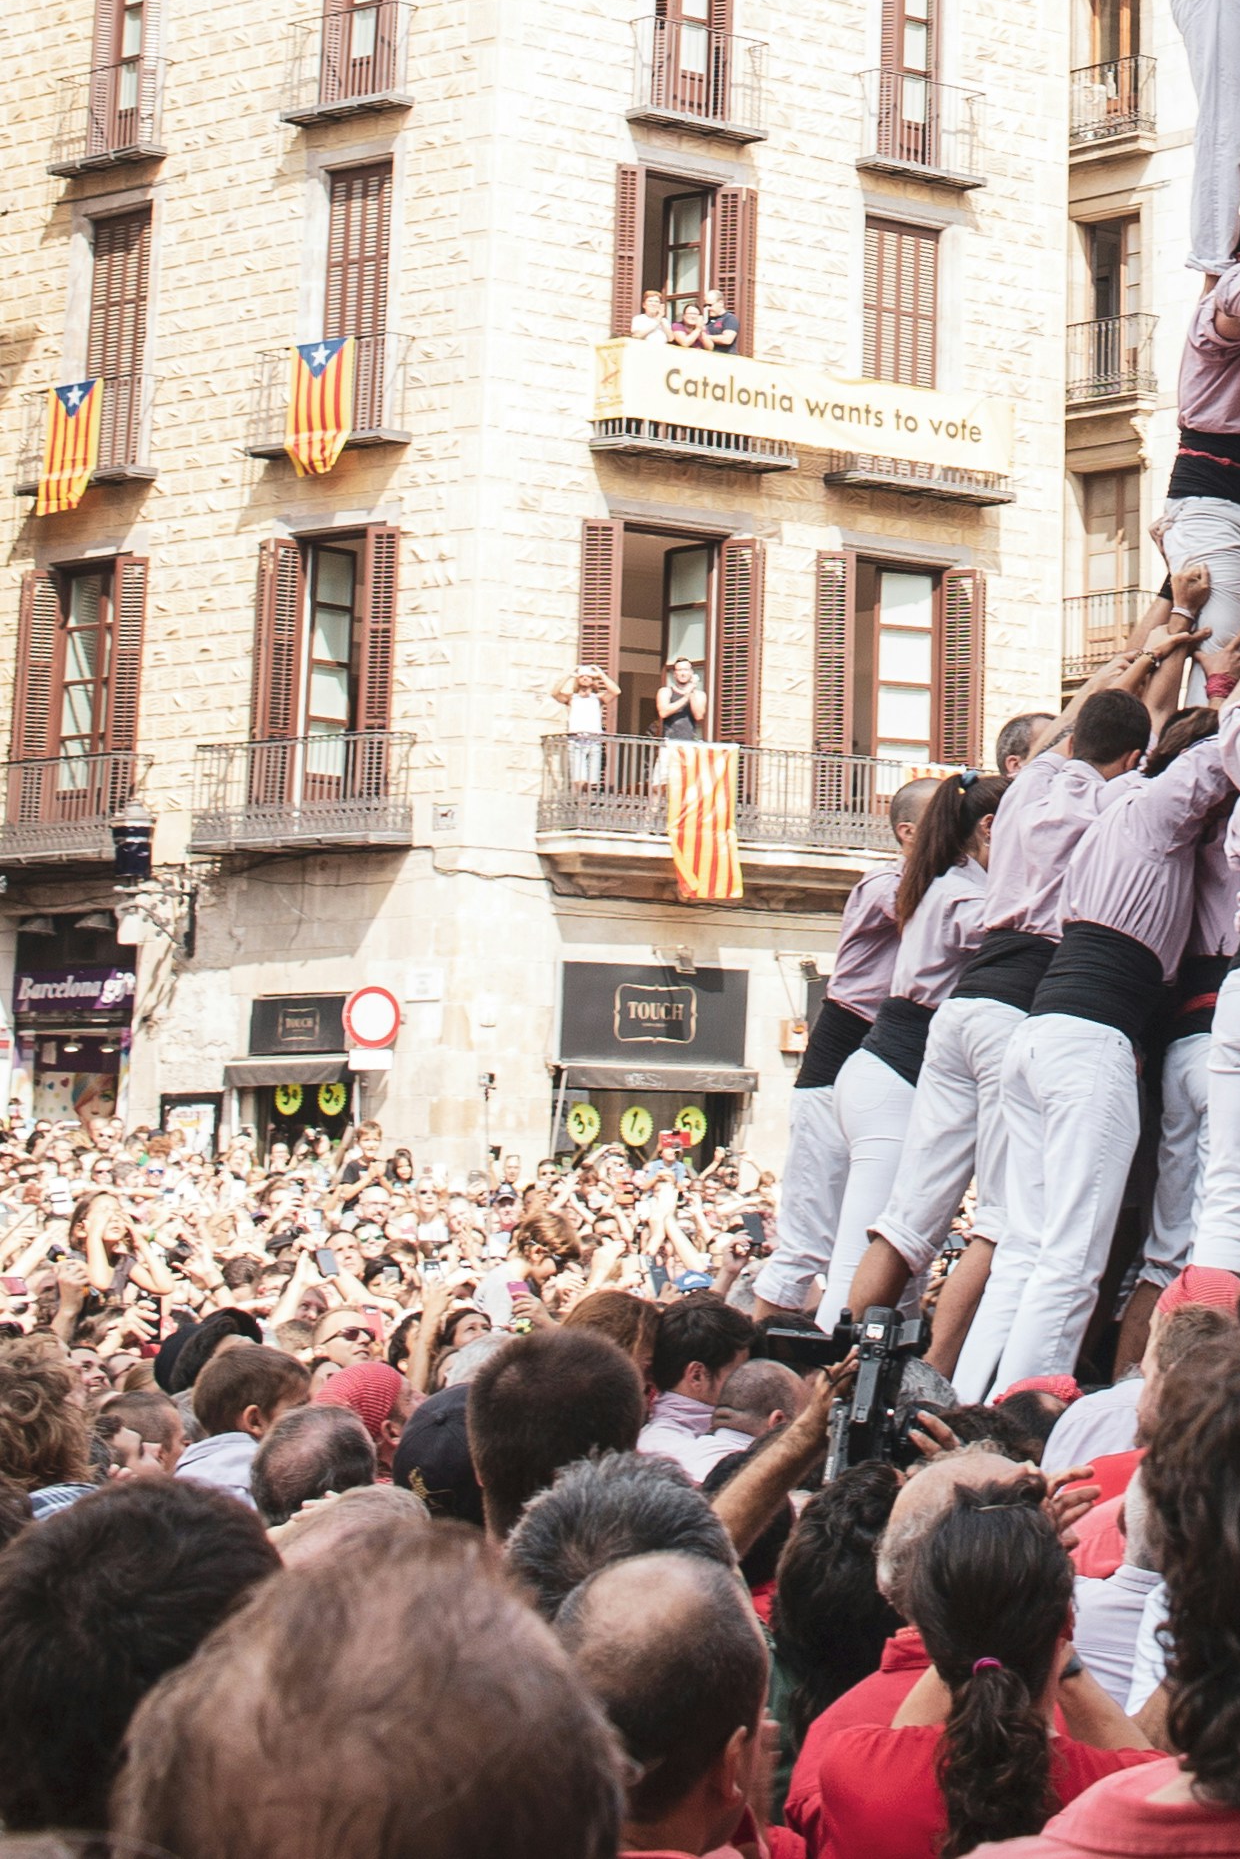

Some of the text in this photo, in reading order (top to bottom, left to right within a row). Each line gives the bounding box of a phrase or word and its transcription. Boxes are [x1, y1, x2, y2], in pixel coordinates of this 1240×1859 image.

[665, 367, 982, 443] Catalonia wants to vote
[17, 975, 102, 1000] Barcelona
[627, 1001, 684, 1021] TOUCH
